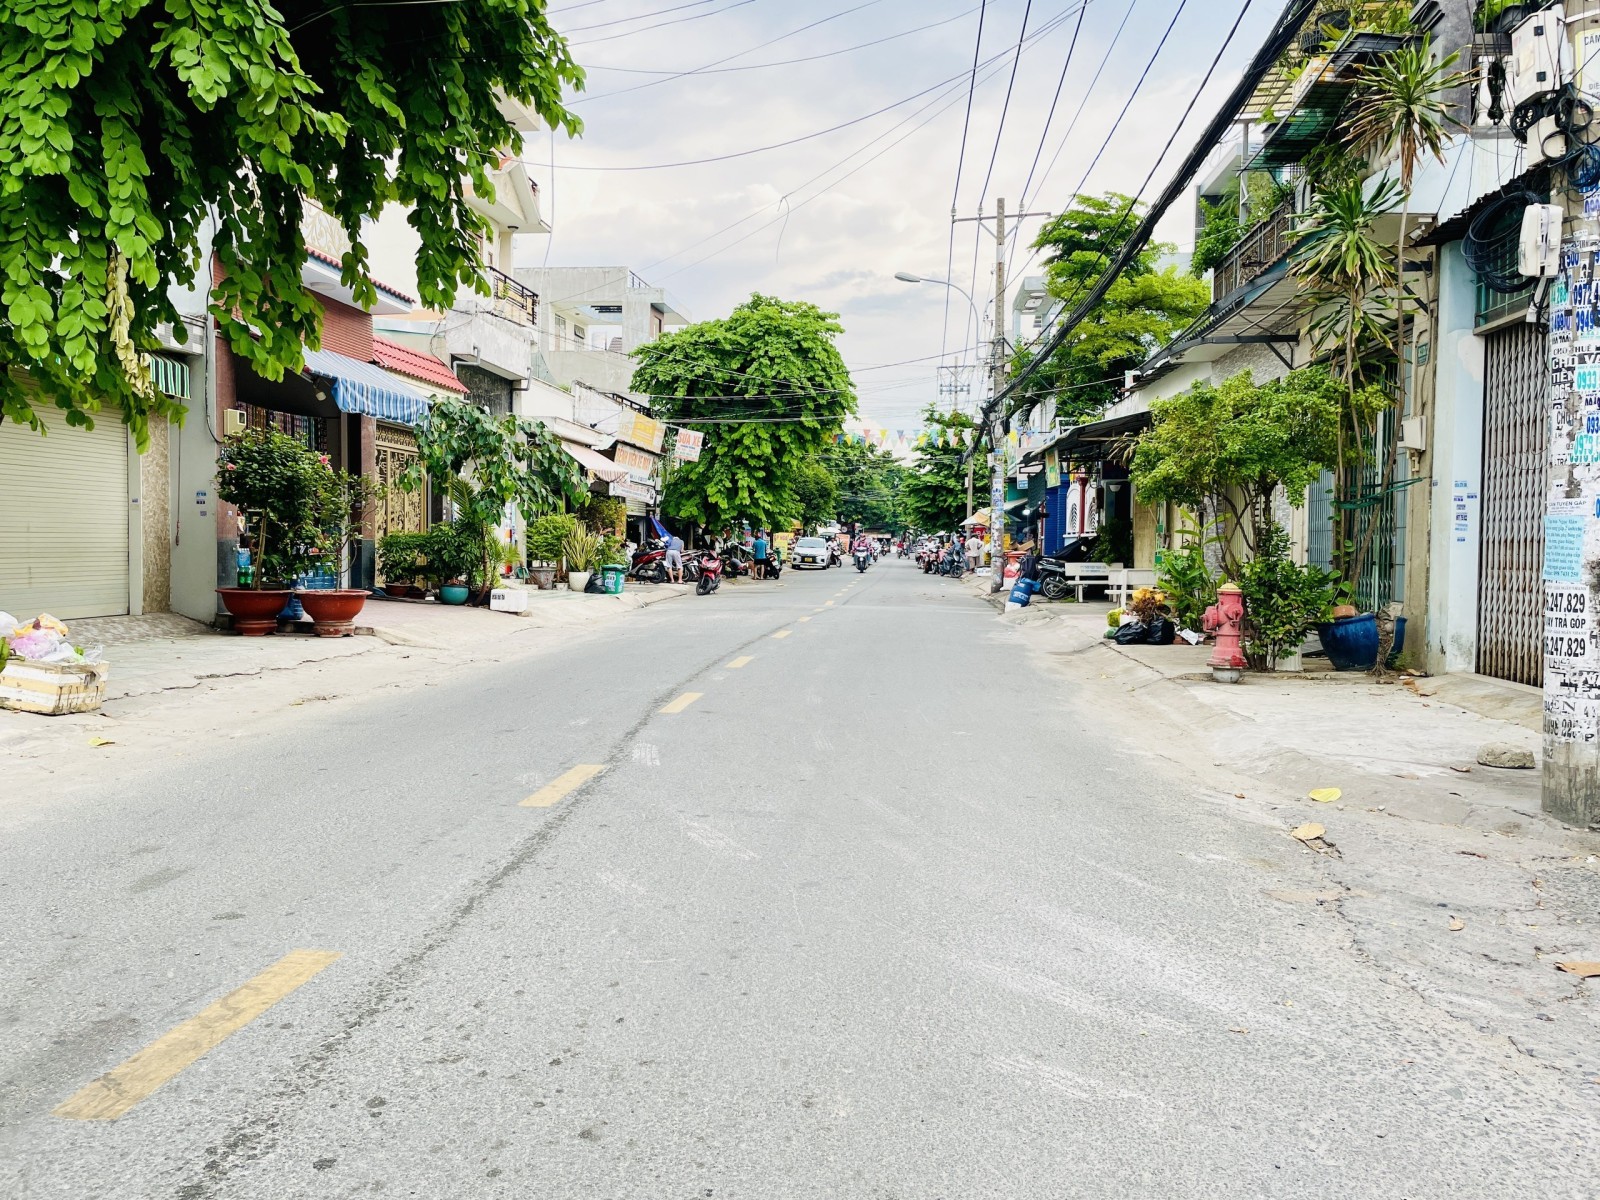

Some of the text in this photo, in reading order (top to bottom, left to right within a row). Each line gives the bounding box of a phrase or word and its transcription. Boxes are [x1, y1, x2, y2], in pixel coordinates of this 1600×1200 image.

[1576, 371, 1597, 390] 0933
[1554, 613, 1568, 628] TRẢ
[1569, 614, 1586, 629] GÓP
